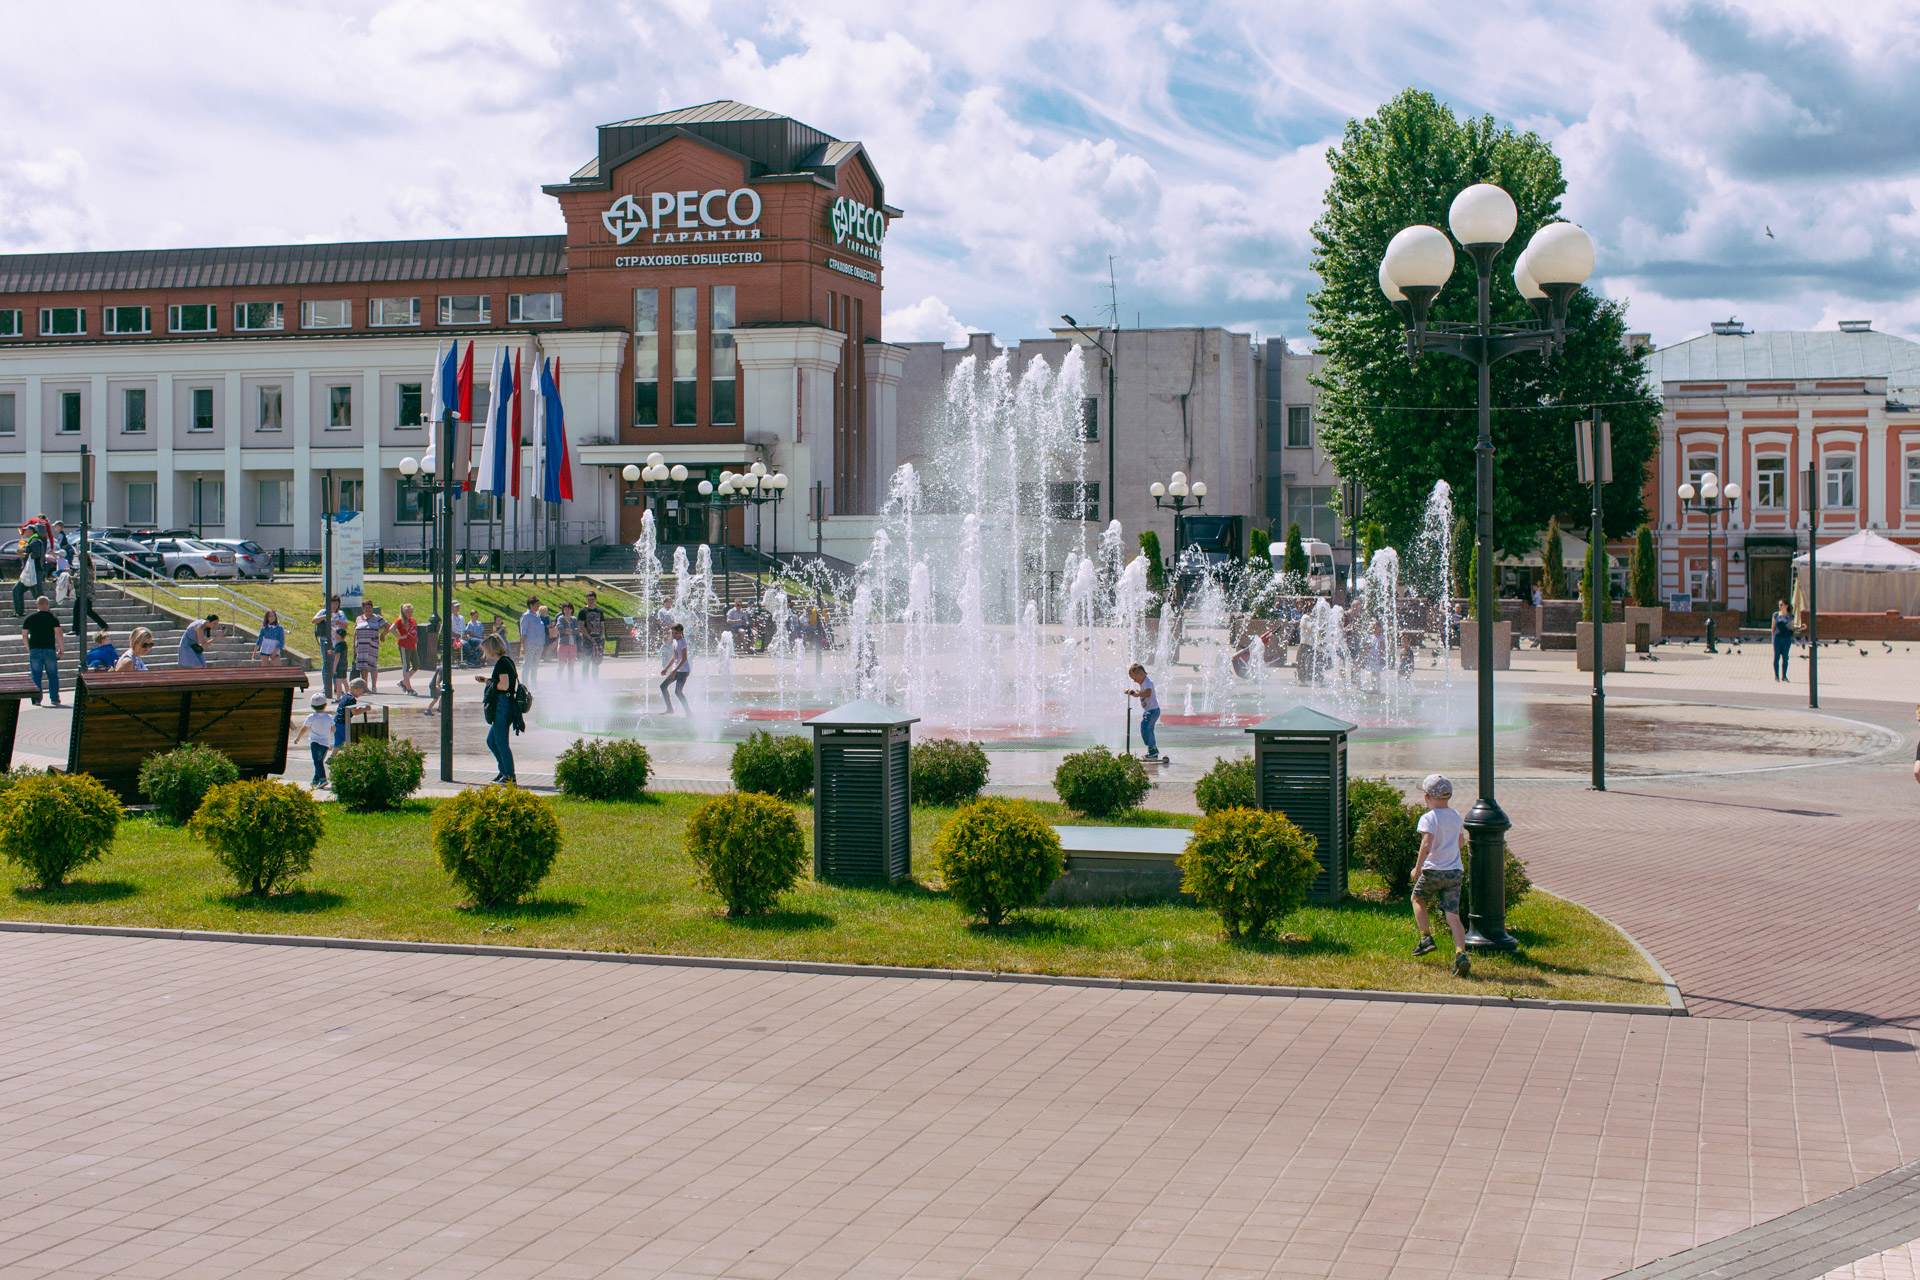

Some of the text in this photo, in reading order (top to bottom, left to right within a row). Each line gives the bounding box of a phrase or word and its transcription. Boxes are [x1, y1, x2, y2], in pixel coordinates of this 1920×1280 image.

[651, 187, 762, 229] РЕСО
[848, 198, 884, 247] РЕСО
[652, 229, 761, 243] ГАРАНТИЯ
[615, 252, 762, 268] СТРАХОВОЕ ОБЩЕСТВО
[829, 258, 877, 283] СТРАХОВОЕ ОБЩЕСТВО
